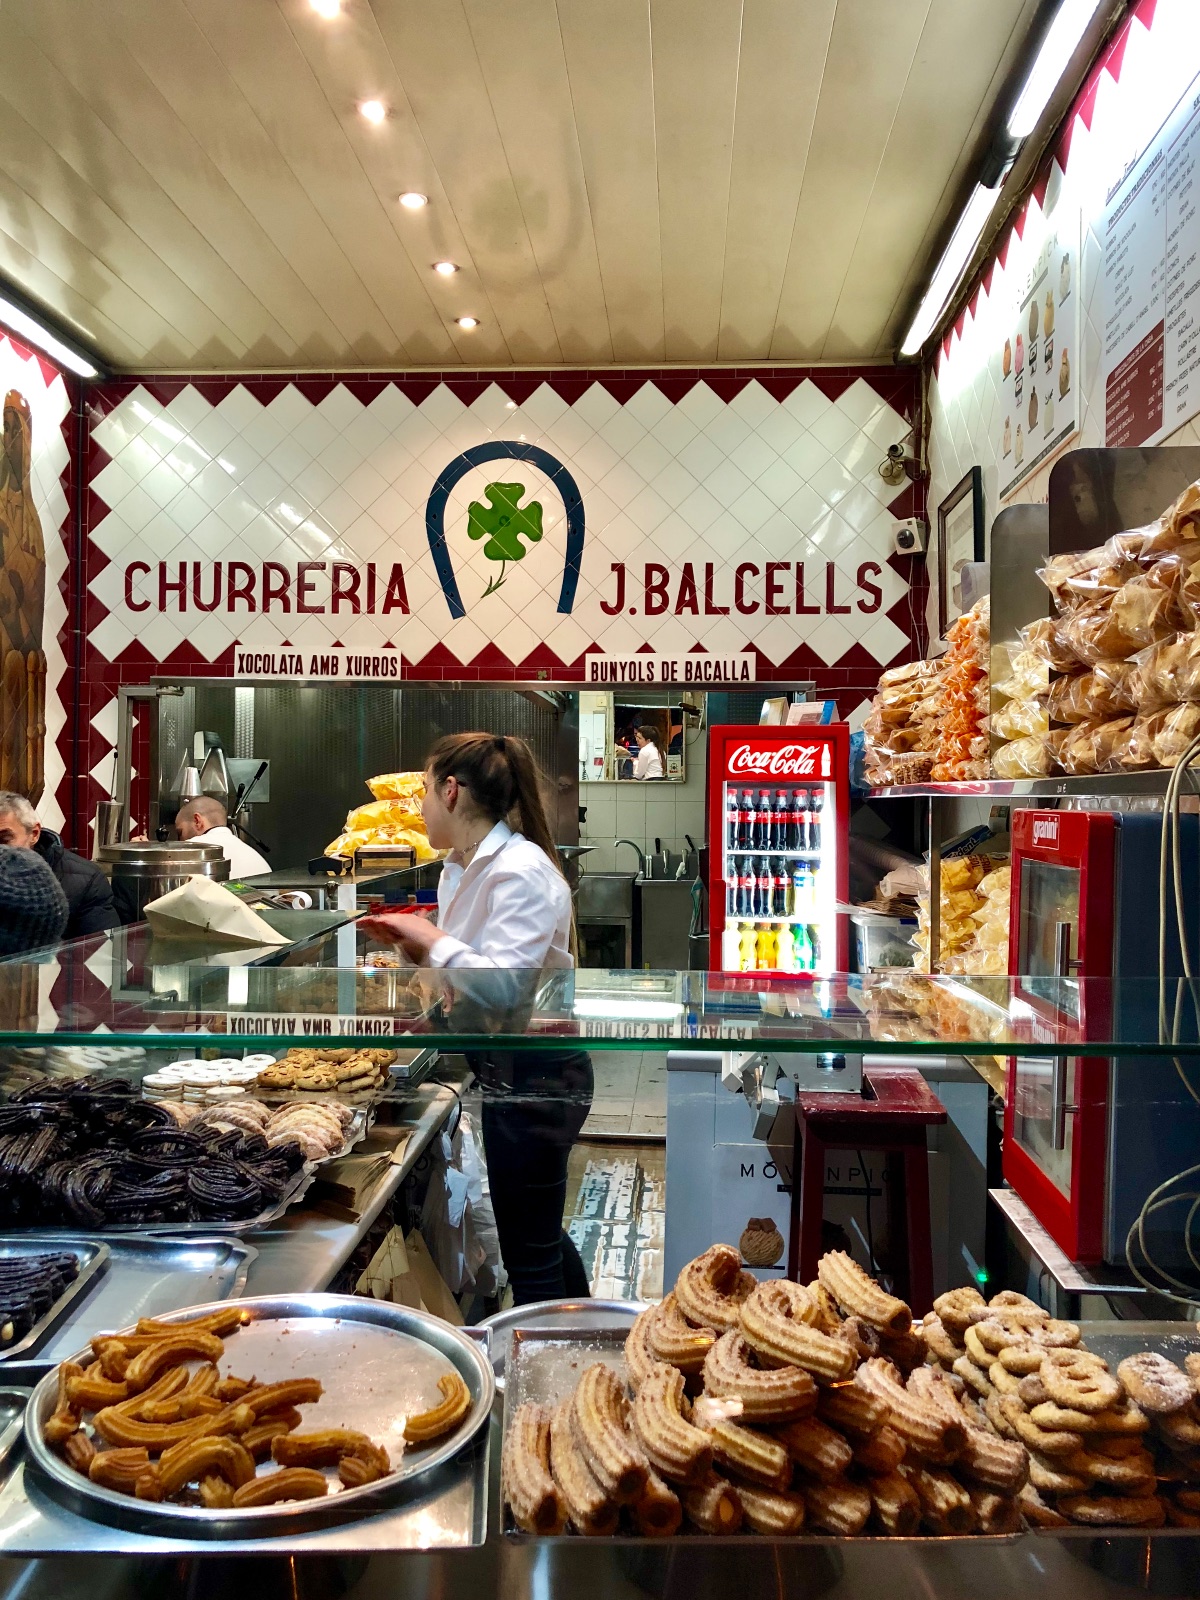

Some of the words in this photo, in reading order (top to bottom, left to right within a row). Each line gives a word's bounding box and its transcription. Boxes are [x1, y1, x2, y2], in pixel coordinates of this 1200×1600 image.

[124, 561, 411, 615] CHURRERIA
[600, 561, 882, 616] J.BALCELLS
[238, 653, 304, 677] XOCOLATA
[310, 655, 339, 676] AMB
[345, 655, 397, 677] XURROS
[590, 661, 655, 683] BUNYOLS
[661, 661, 678, 682] DE
[684, 660, 750, 682] BACALLA
[728, 745, 820, 775] Coca-Cola
